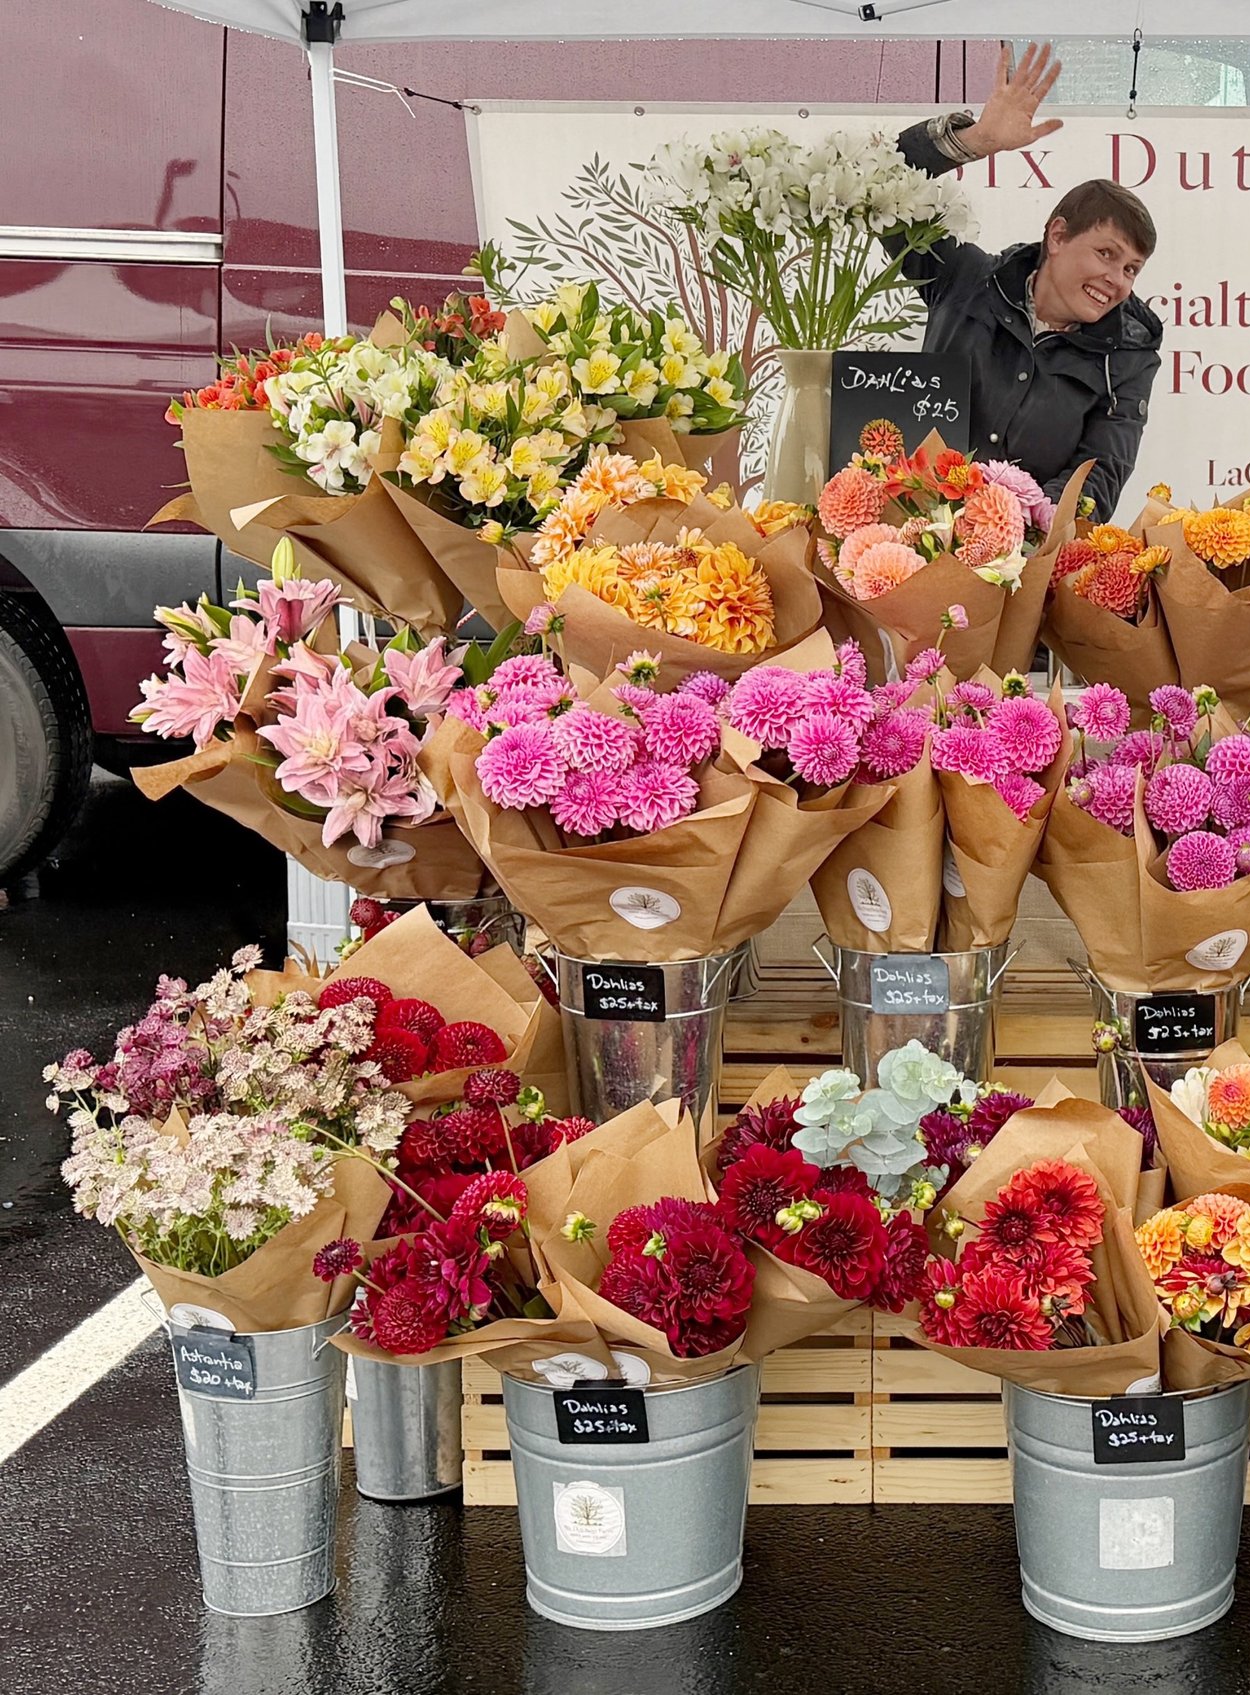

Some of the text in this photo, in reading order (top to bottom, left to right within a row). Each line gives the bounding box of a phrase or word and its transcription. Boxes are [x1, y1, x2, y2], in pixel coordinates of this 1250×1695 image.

[956, 150, 1055, 189] ix
[912, 394, 960, 422] $25
[586, 973, 645, 992] Dahlias
[873, 967, 933, 985] Dahlias
[1138, 1005, 1196, 1020] Dahlias
[189, 1366, 221, 1386] $20
[562, 1399, 628, 1415] Dahlias
[1095, 1409, 1158, 1427] Dahlias
